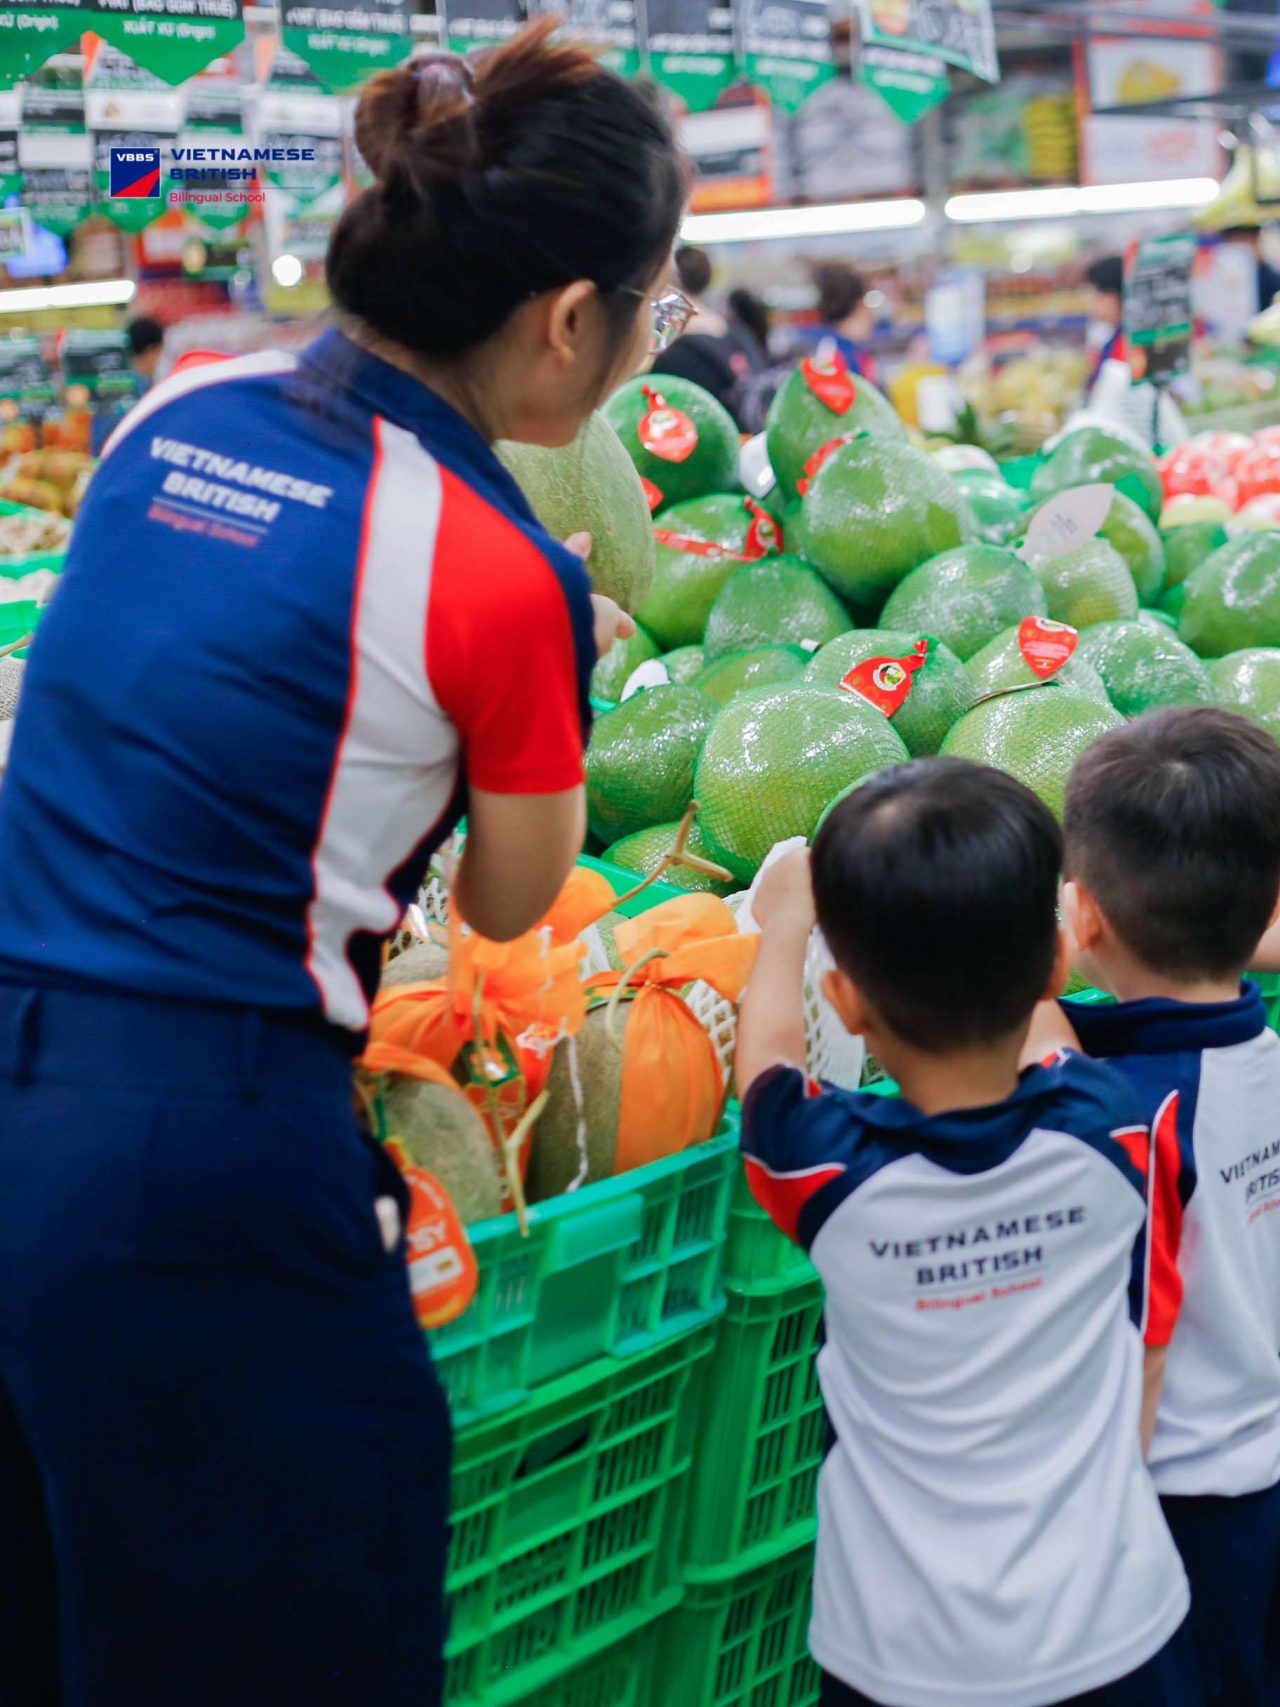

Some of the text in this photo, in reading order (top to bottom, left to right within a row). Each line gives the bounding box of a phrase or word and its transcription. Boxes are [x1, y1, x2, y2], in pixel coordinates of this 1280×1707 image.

[150, 436, 334, 508] VIETNAMESE
[162, 470, 282, 523] BRITISH
[868, 1205, 1086, 1259] VIETNAMESE
[915, 1245, 1043, 1286] BRITISH
